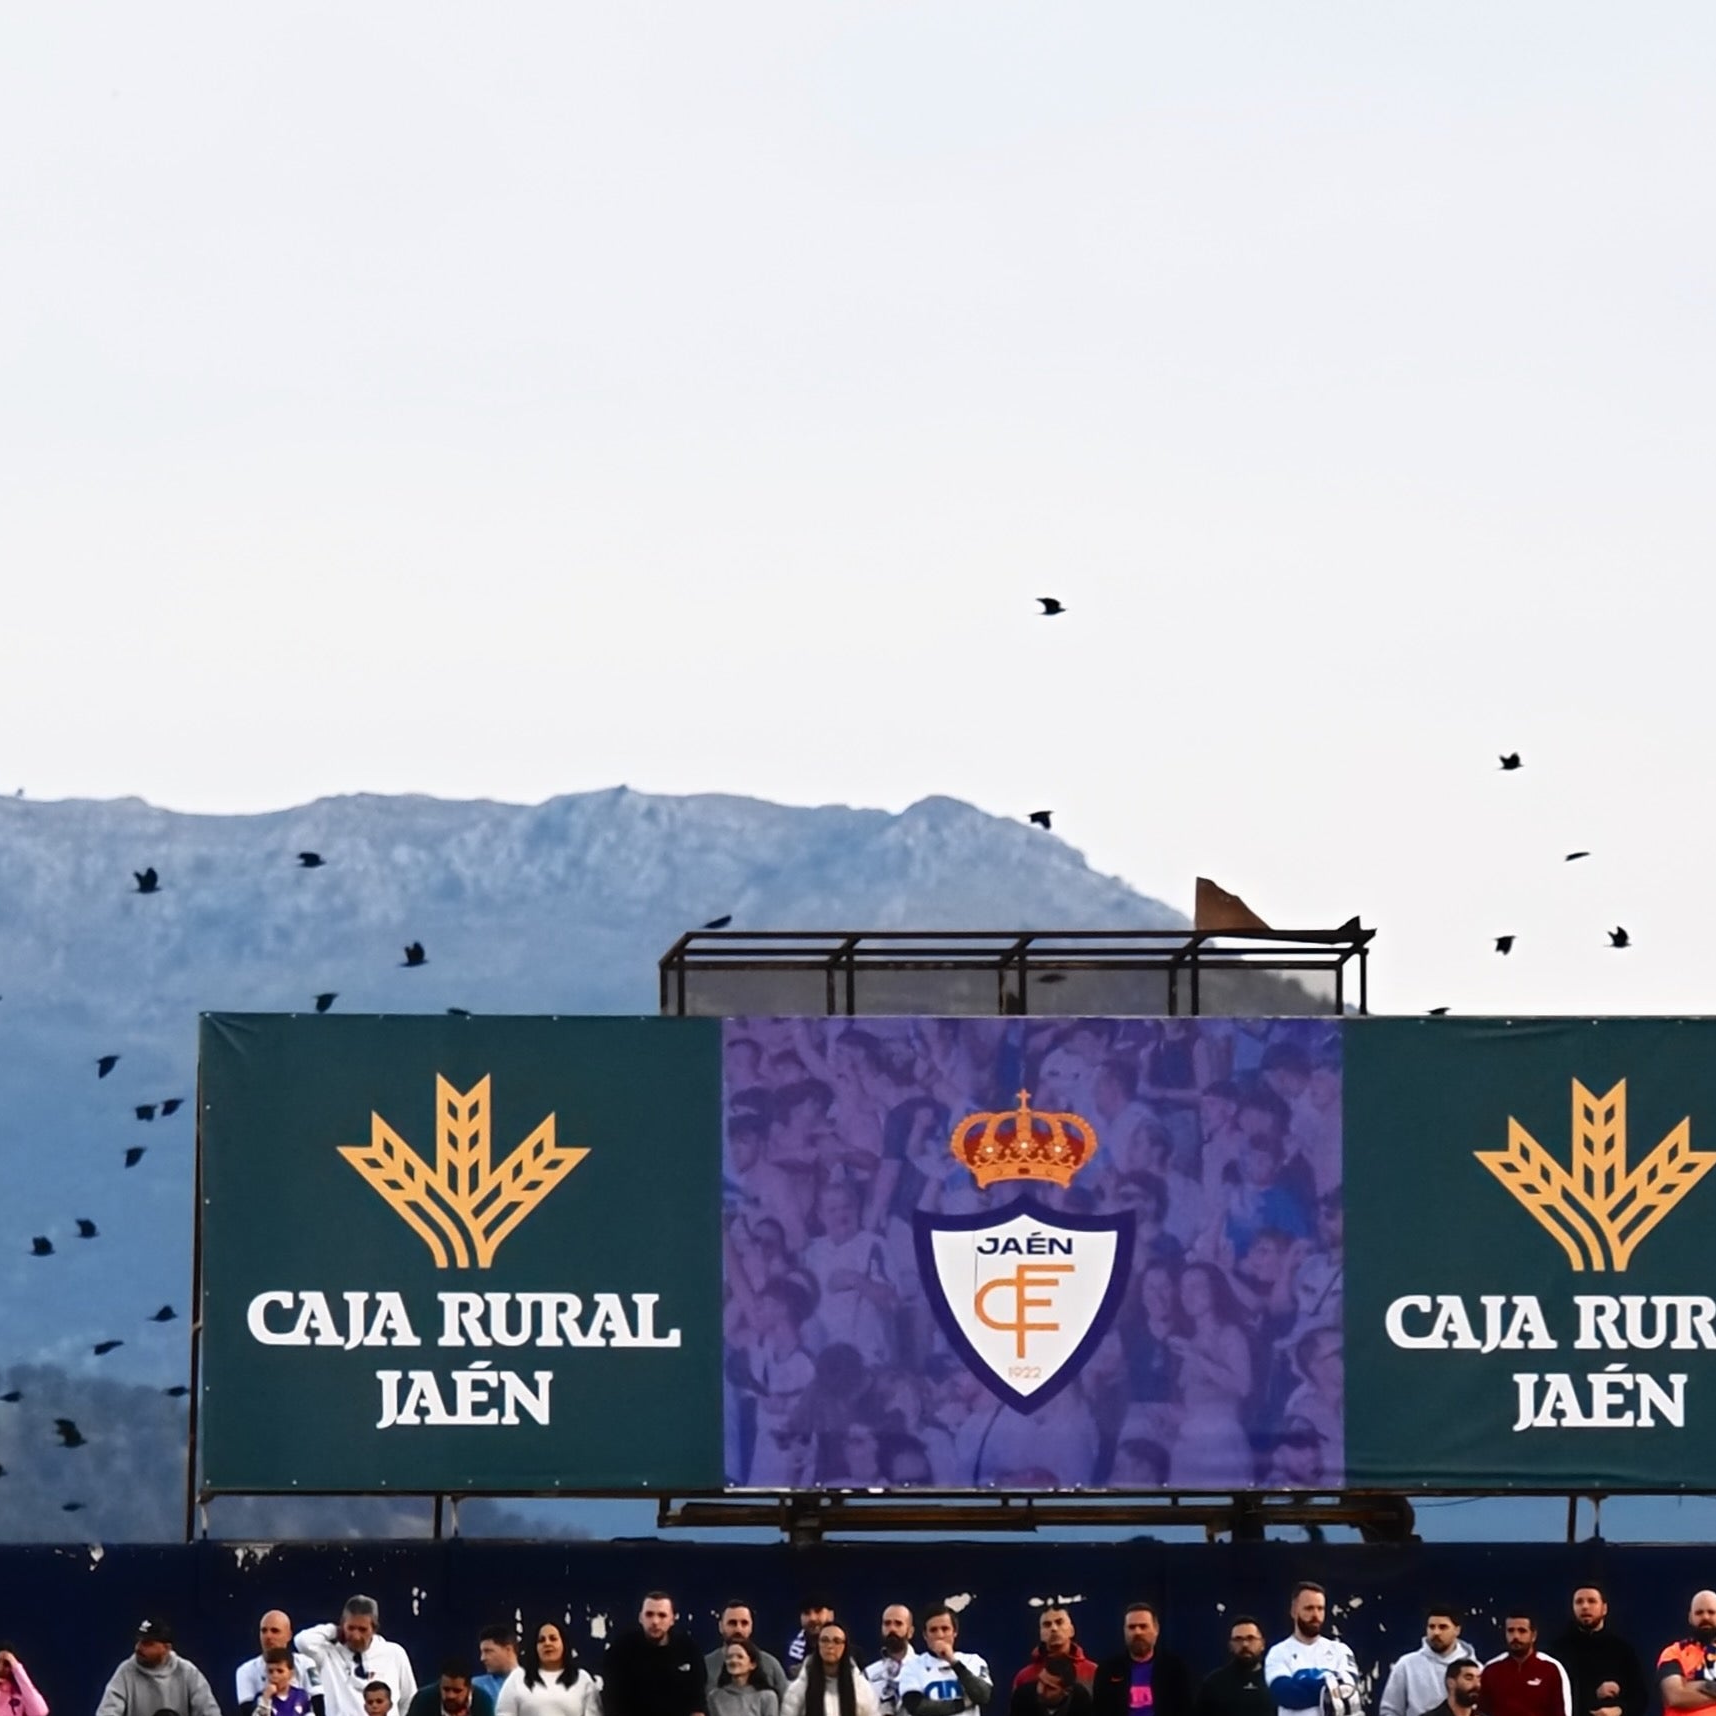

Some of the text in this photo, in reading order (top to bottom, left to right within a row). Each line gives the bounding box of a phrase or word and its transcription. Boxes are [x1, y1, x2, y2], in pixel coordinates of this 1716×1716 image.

[976, 1232, 1073, 1256] JAÉN
[246, 1290, 682, 1351] CAJA RURAL
[1384, 1294, 1558, 1355] CAJA
[376, 1360, 554, 1430] JAÉN
[1513, 1363, 1688, 1433] JAÉN
